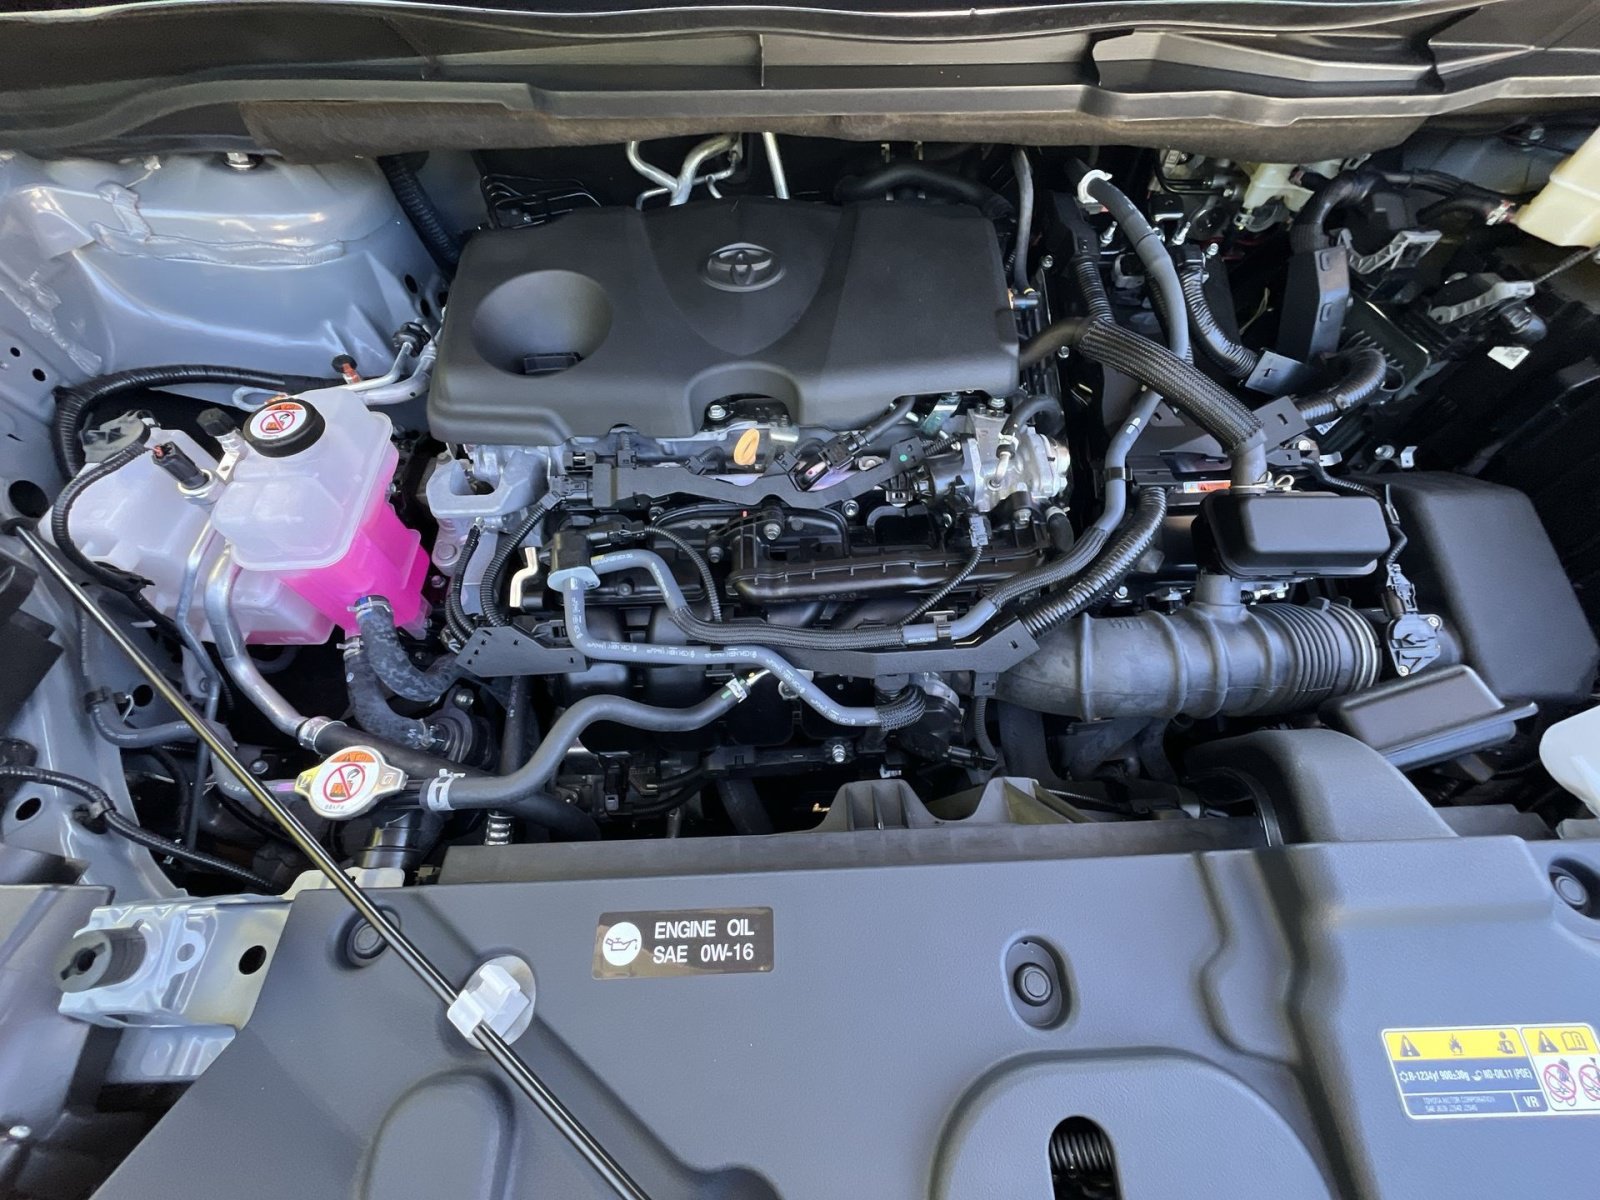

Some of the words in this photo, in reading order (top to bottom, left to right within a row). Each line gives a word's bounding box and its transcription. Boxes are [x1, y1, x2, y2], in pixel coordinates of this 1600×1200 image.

[654, 920, 716, 939] ENGINE
[726, 919, 755, 937] OIL
[652, 945, 688, 964] SAE
[700, 943, 755, 962] 0W-16
[1522, 1095, 1541, 1108] VR
